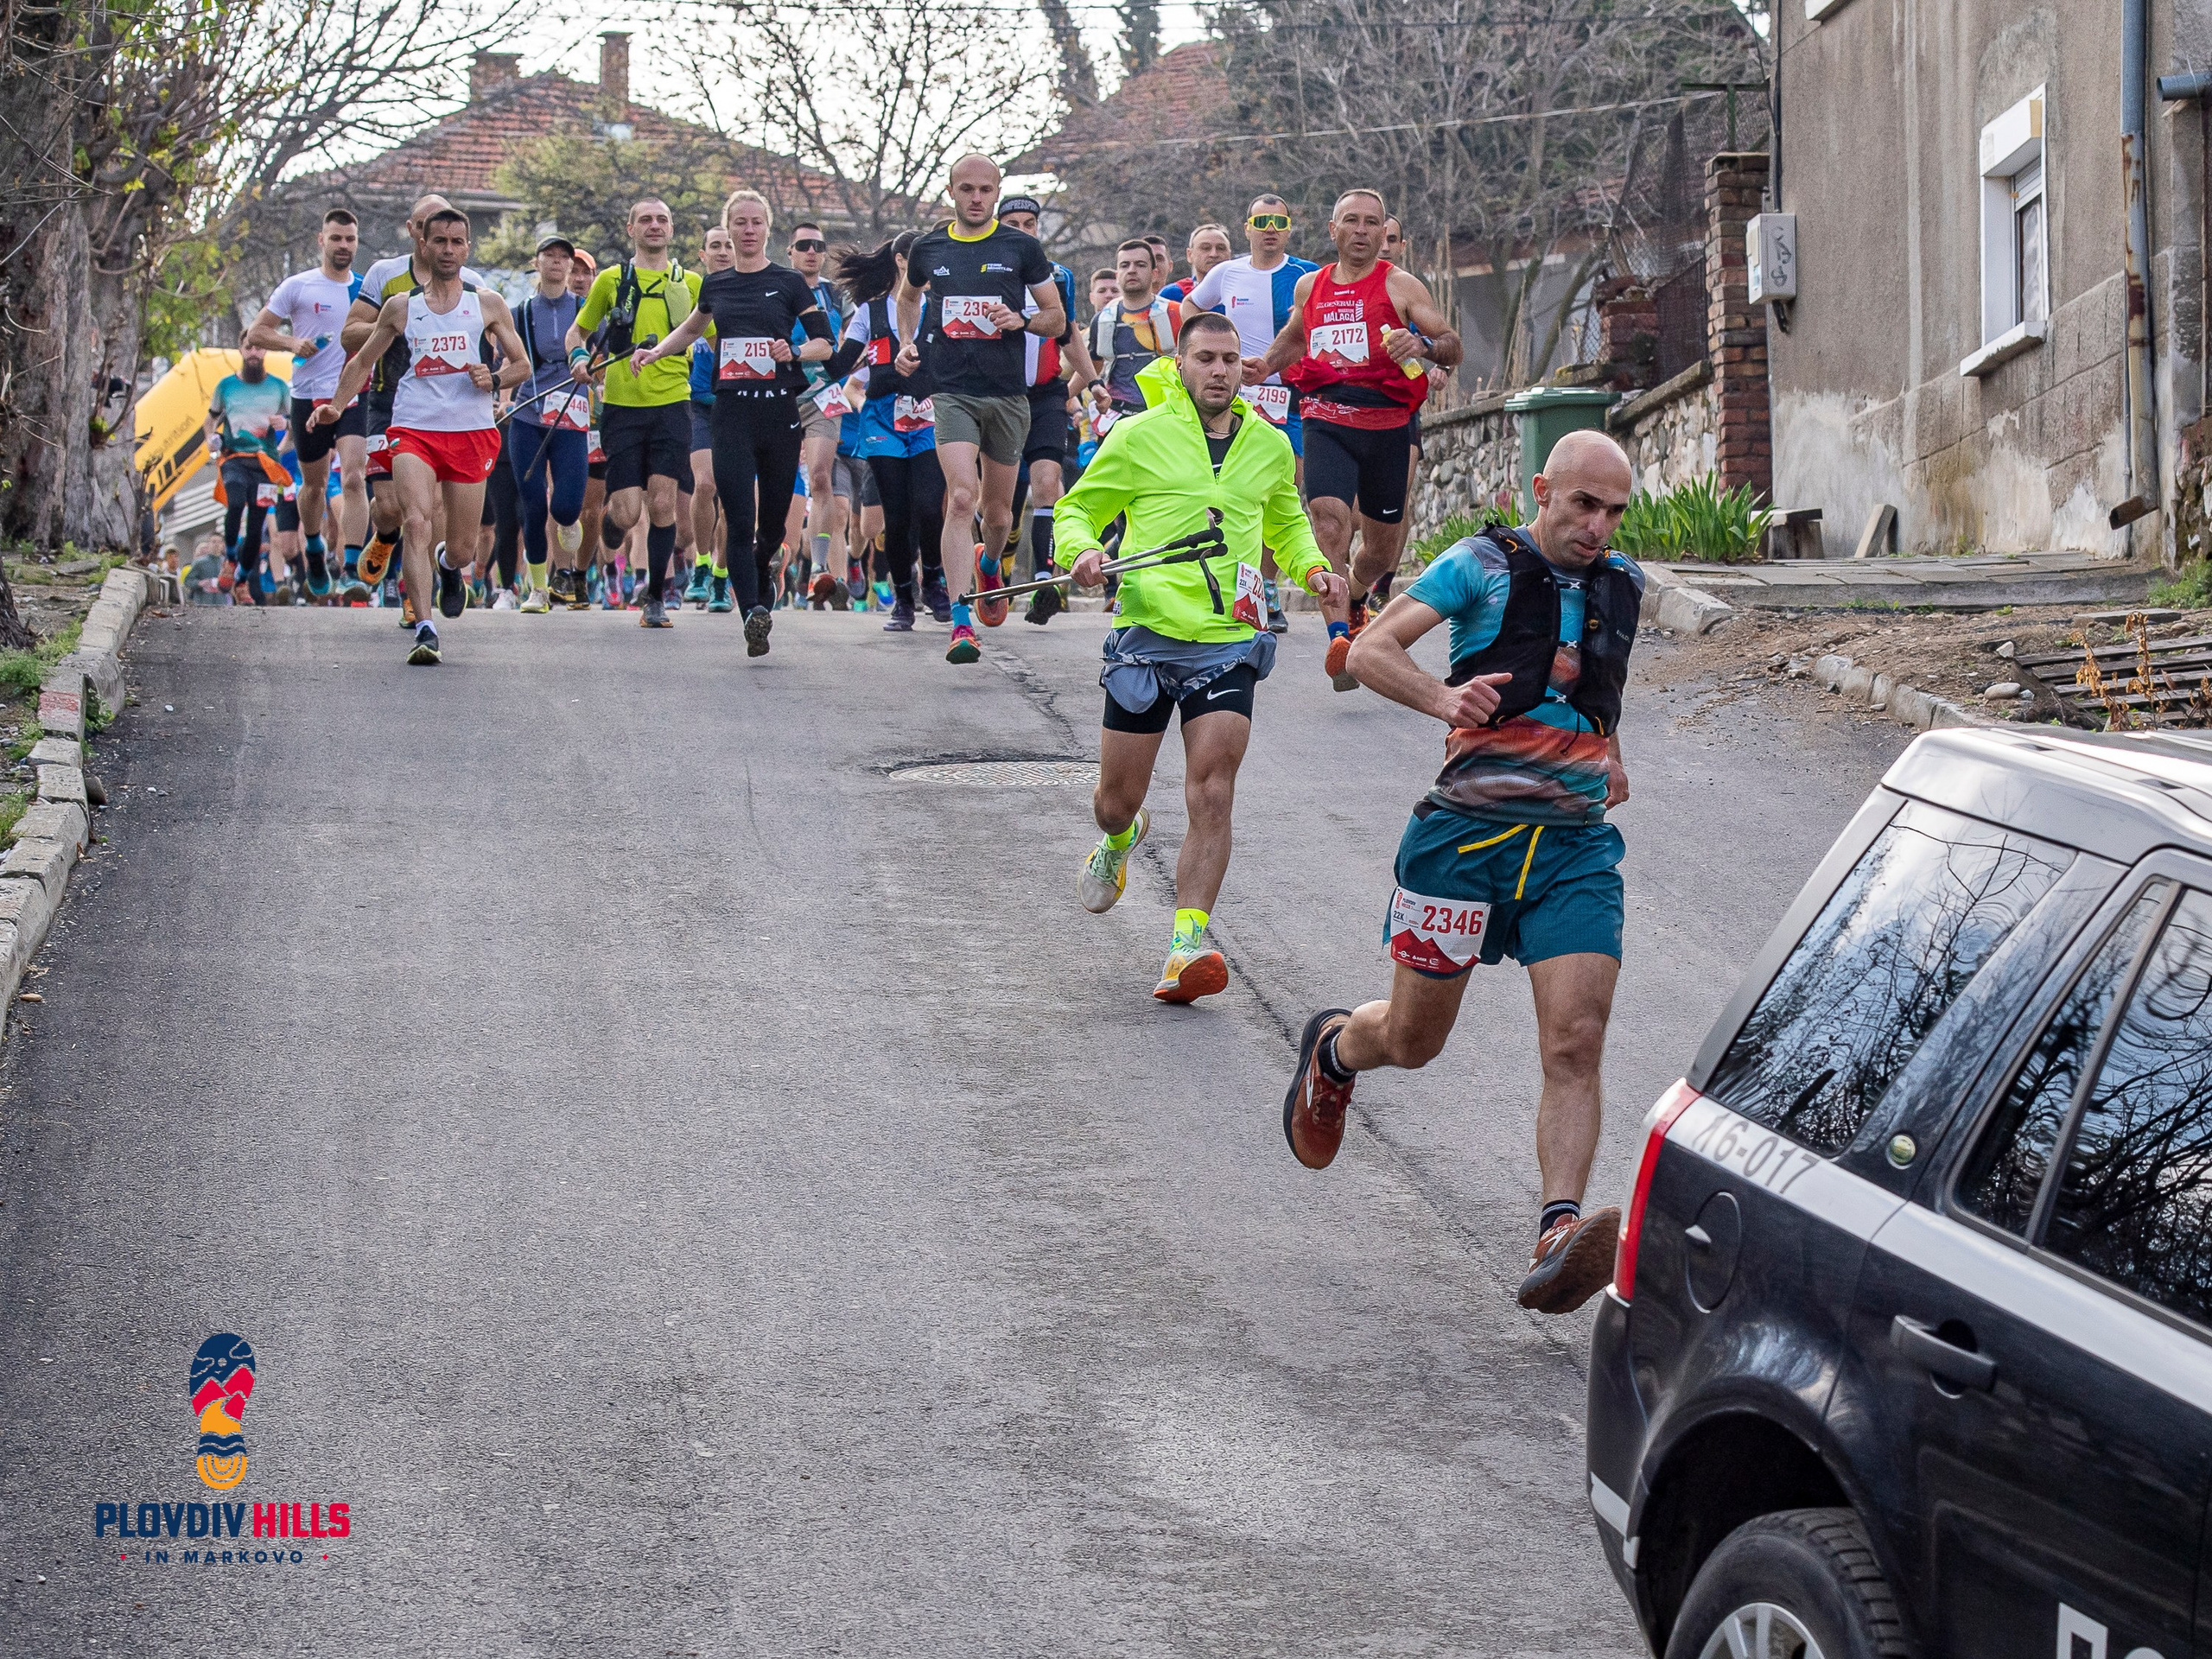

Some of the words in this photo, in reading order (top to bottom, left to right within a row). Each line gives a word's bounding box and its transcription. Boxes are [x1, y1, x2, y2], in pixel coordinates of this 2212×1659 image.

[432, 335, 467, 353] 2373
[1332, 328, 1363, 345] 2172
[745, 342, 767, 357] 215
[1257, 387, 1287, 404] 2199
[564, 397, 588, 413] 446
[1421, 905, 1484, 936] 2346
